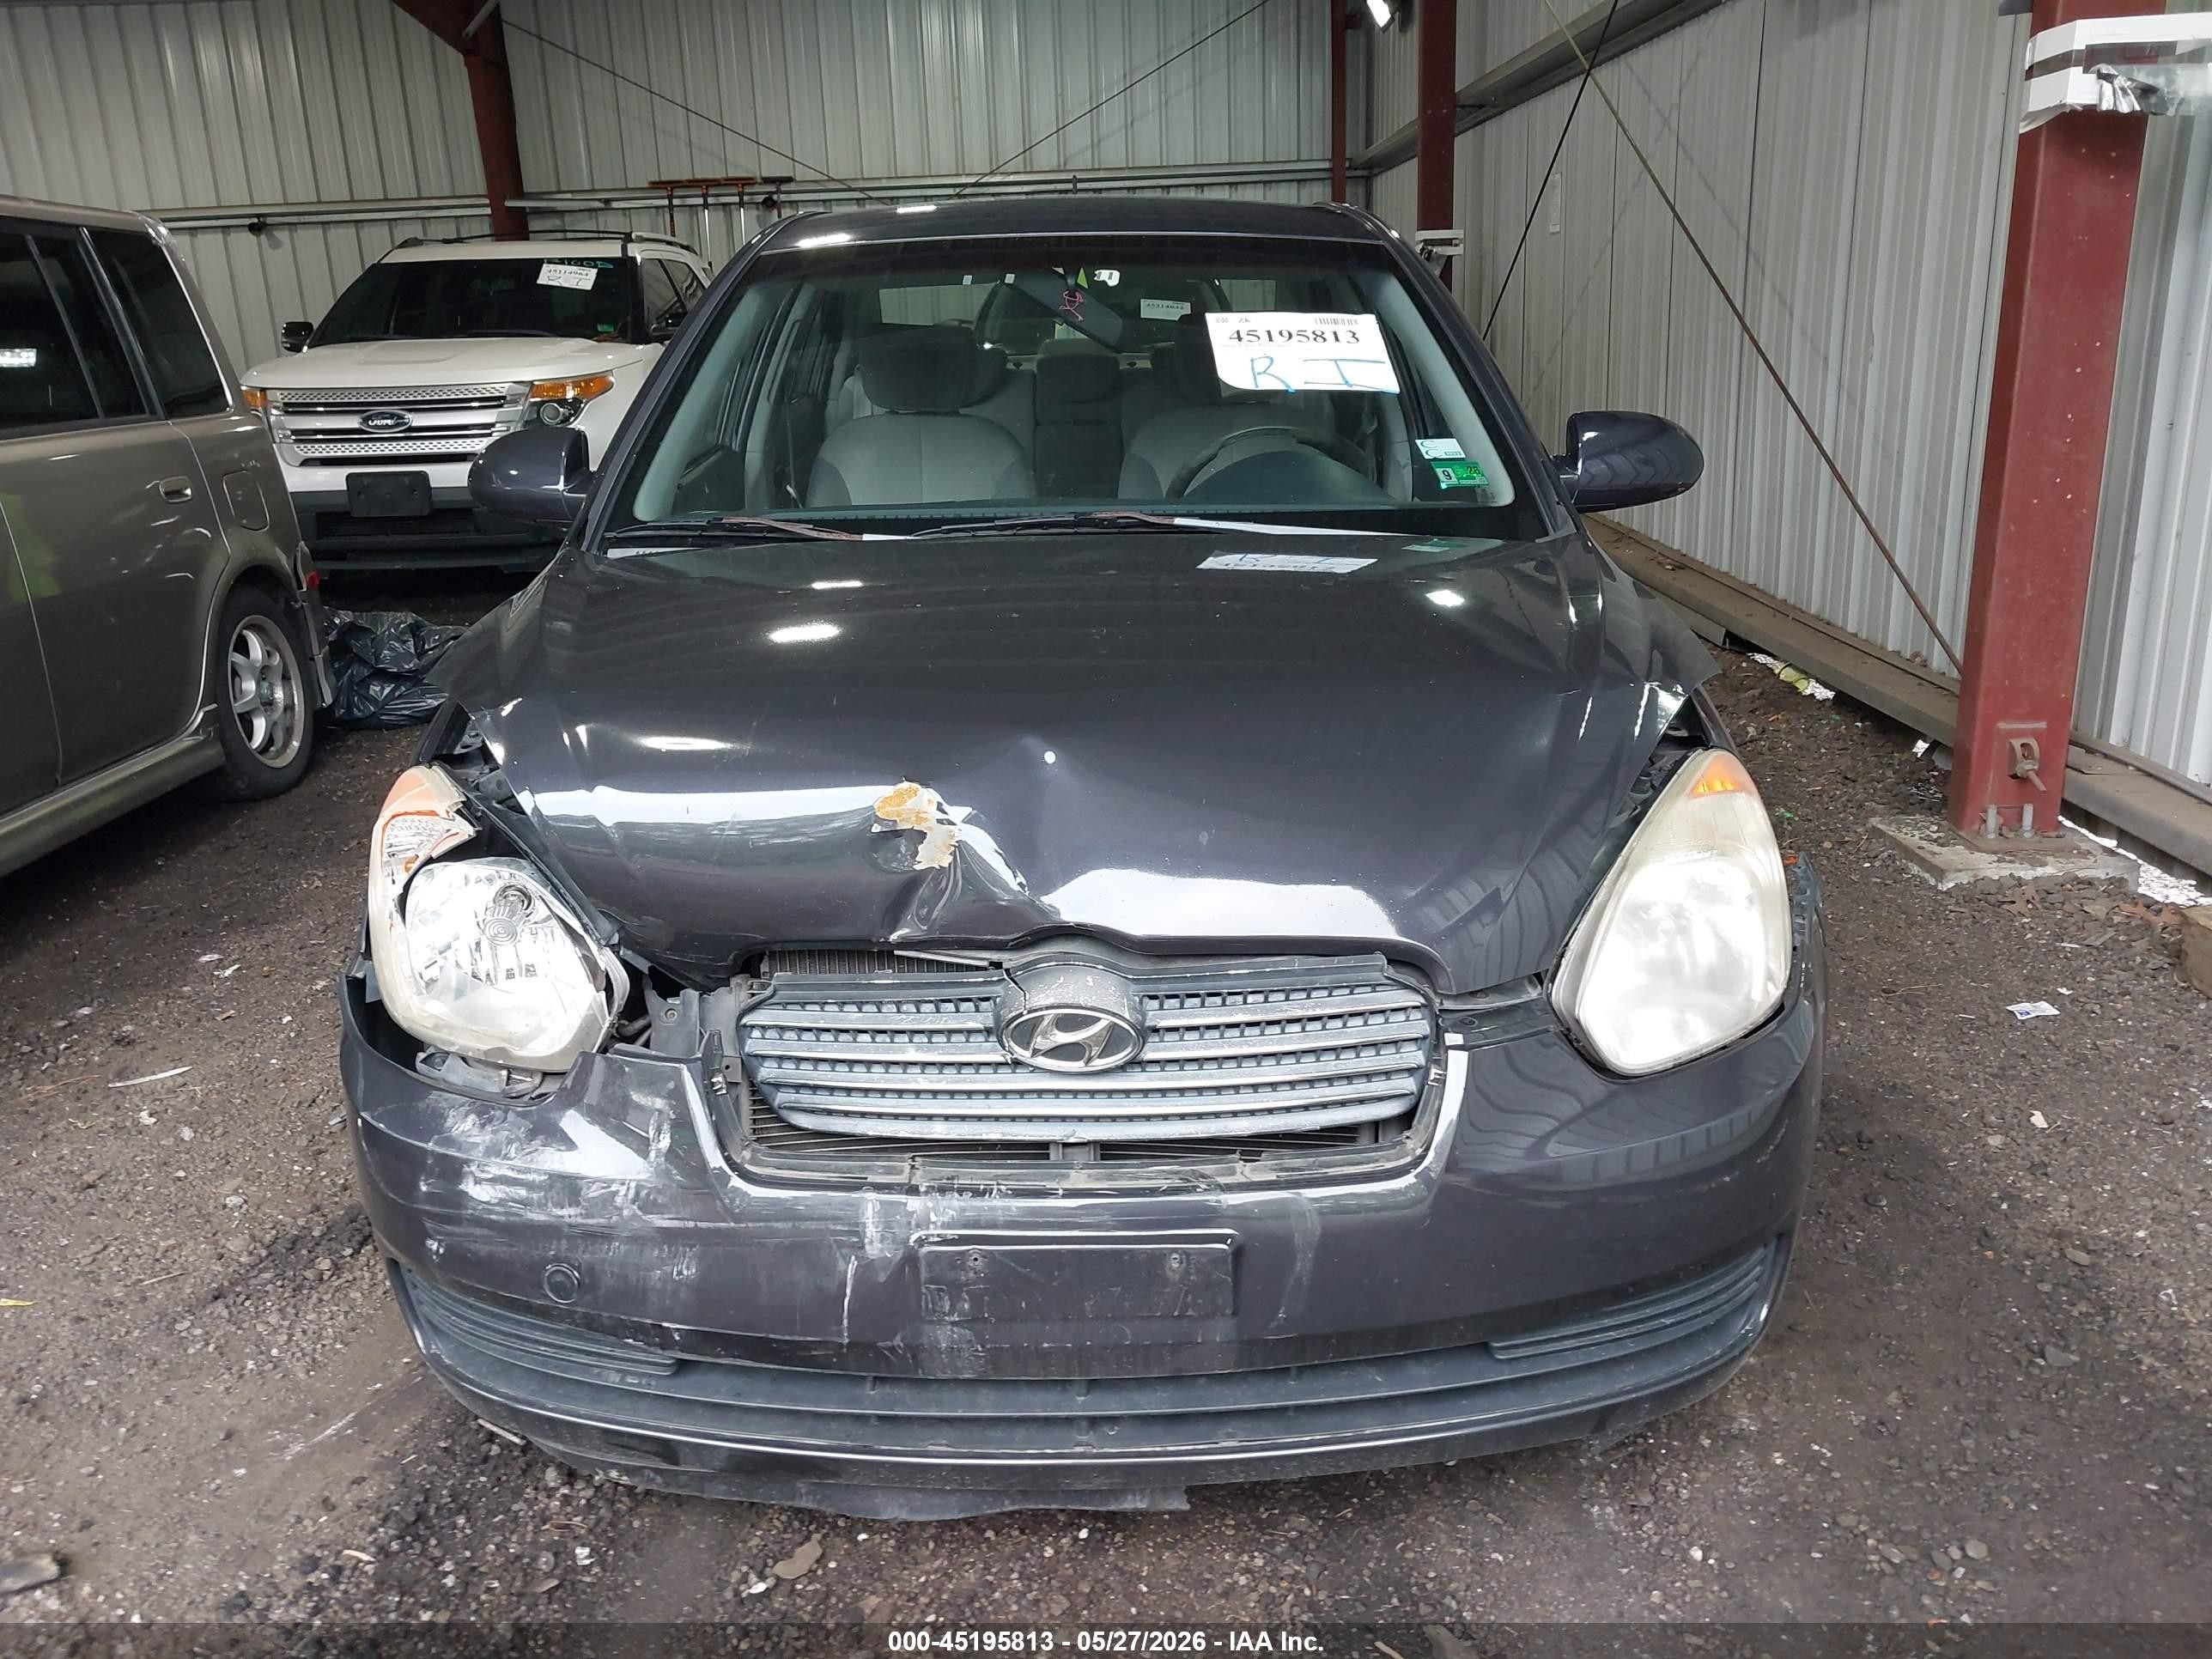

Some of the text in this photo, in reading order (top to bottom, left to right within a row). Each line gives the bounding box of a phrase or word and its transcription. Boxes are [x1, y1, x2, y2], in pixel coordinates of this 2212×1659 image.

[1229, 329, 1360, 344] 45195813
[1250, 355, 1296, 394] R
[1442, 469, 1453, 481] 9
